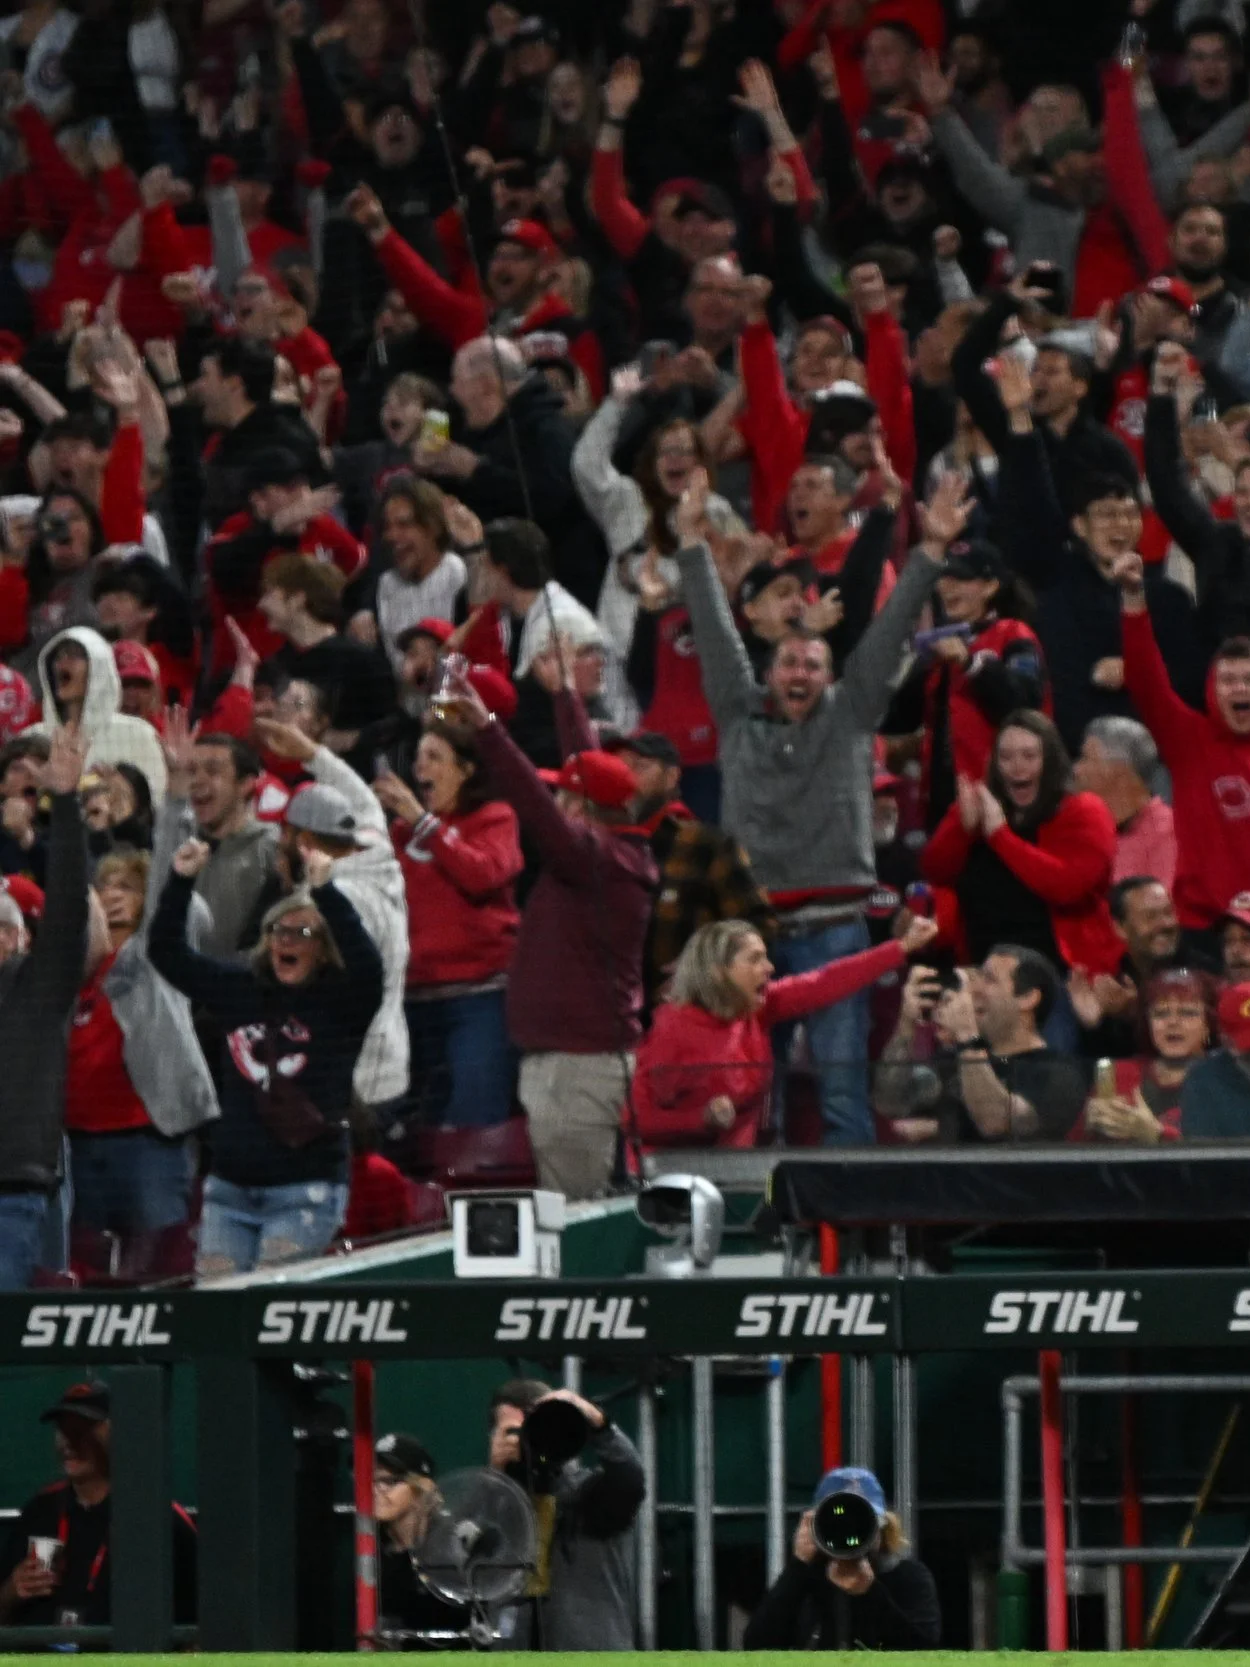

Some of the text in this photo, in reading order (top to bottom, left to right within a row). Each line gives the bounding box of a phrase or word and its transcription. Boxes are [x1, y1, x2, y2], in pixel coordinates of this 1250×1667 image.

[22, 1304, 169, 1346] STIHL
[258, 1301, 406, 1342] STIHL
[495, 1298, 645, 1339] STIHL
[736, 1294, 886, 1336] STIHL
[985, 1291, 1138, 1332] STIHL
